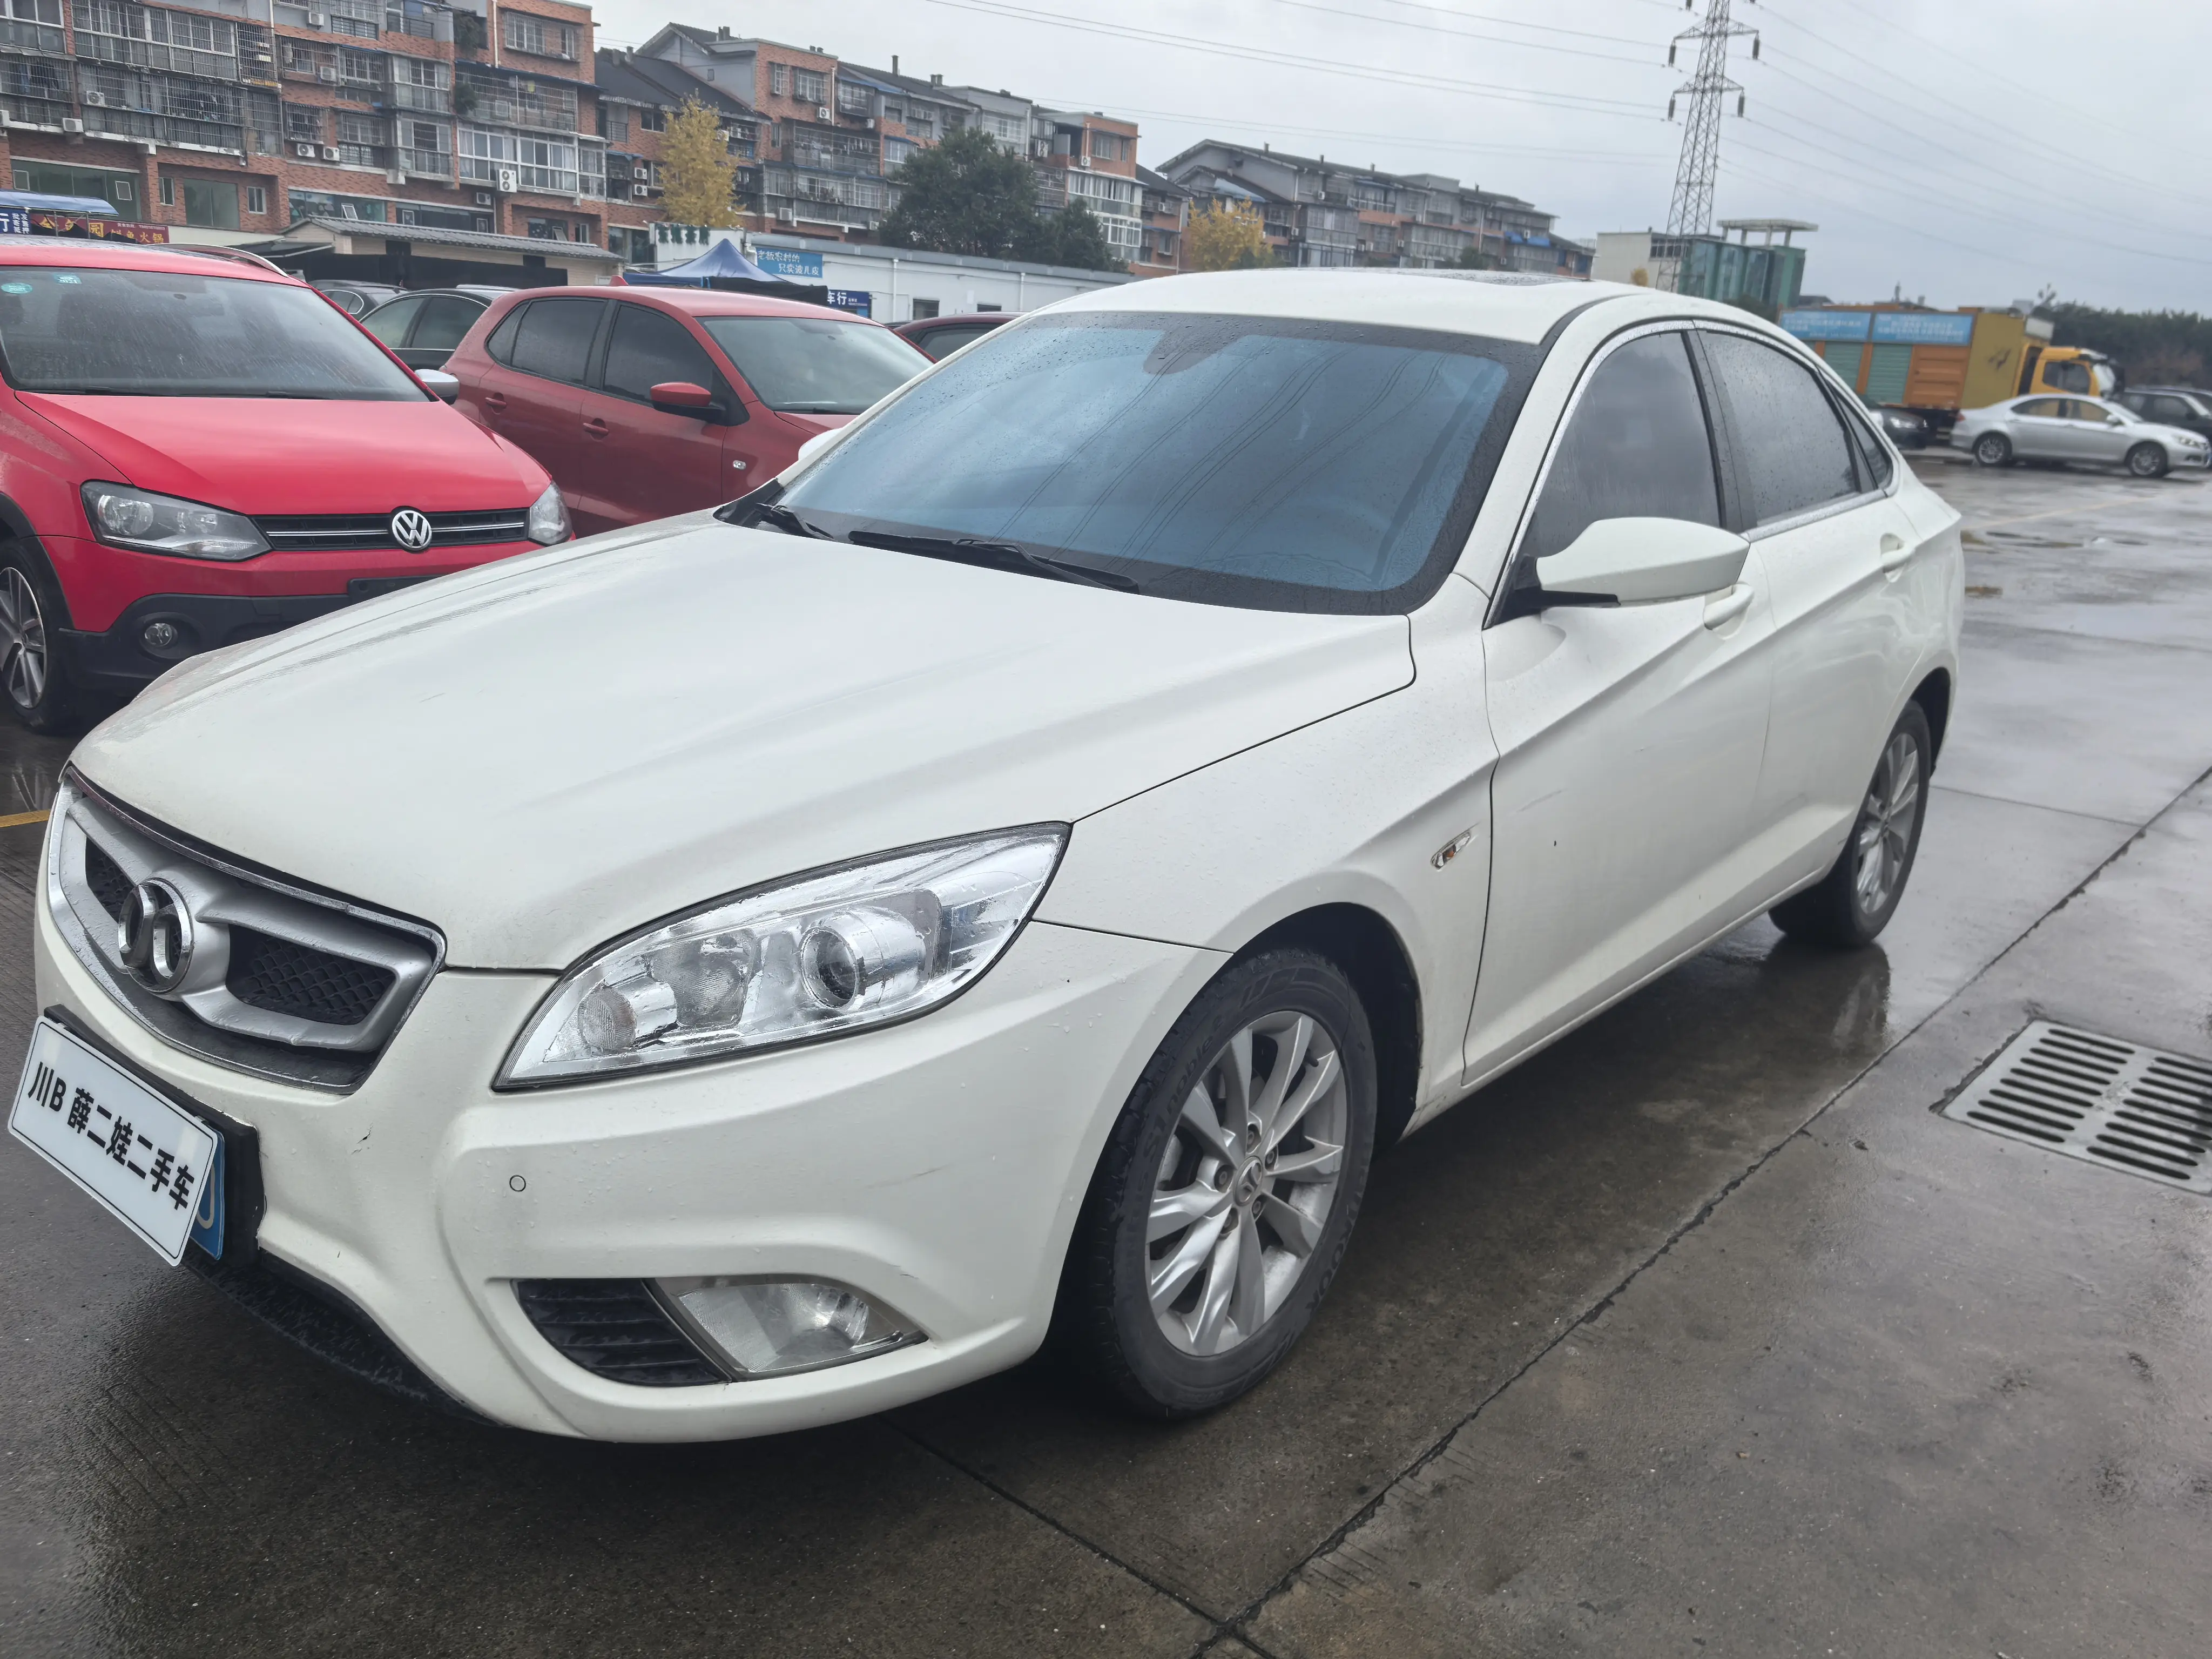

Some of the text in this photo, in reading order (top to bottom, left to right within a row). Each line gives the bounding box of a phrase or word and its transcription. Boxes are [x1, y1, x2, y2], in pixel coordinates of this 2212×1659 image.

[827, 291, 847, 305] 车行
[28, 1061, 66, 1112] 川B
[67, 1087, 195, 1211] 薛二娃二手车
